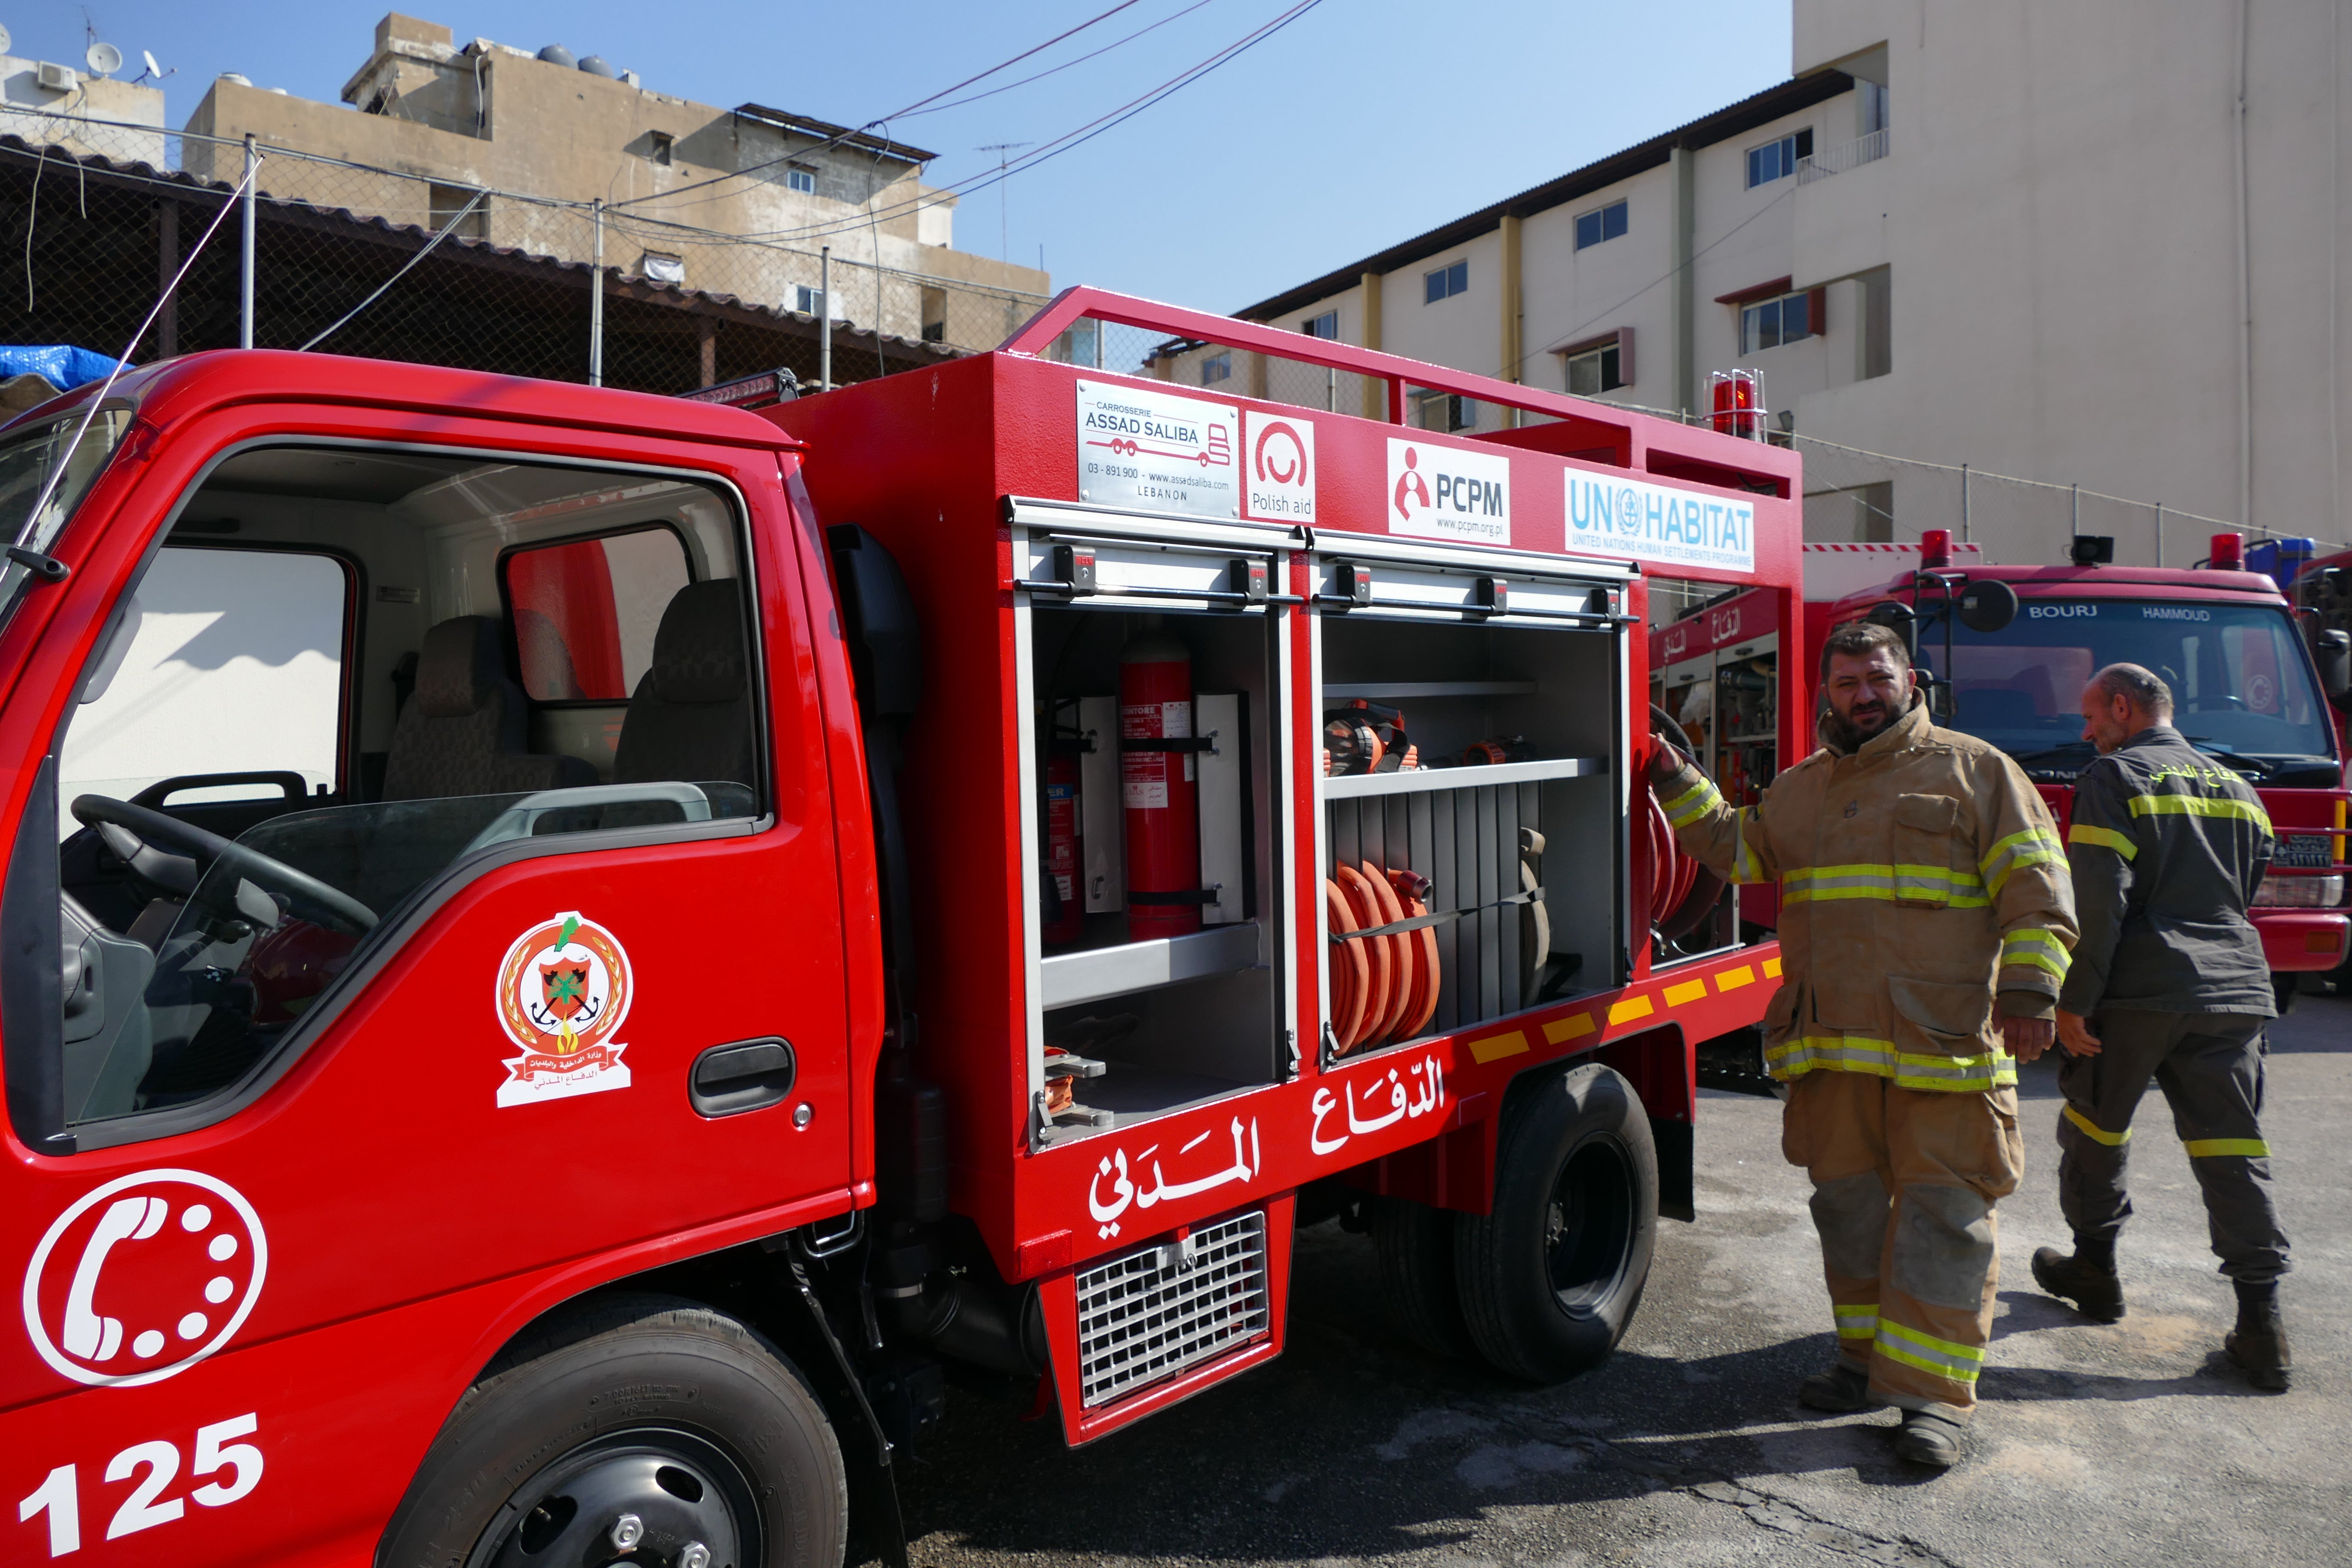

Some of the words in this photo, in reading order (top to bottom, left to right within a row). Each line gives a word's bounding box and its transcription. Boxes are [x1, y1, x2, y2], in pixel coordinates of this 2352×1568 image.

[1096, 401, 1152, 417] CARROSSERIE
[1085, 412, 1140, 434] ASSAD
[1144, 421, 1198, 444] SALIBA
[1088, 463, 1098, 473] 03
[1106, 466, 1121, 477] 891
[1123, 468, 1138, 479] 900
[1149, 472, 1229, 490] www.assadsaliba.com
[1138, 485, 1188, 501] LEBANON
[1253, 493, 1289, 512] Polish
[1293, 498, 1311, 514] aid
[1436, 473, 1503, 517] PCPM
[1571, 478, 1612, 533] UN
[1645, 492, 1751, 551] HABITAT
[1437, 517, 1503, 536] www.pcpm.org.pl
[1572, 533, 1602, 548] UNITED
[1603, 537, 1635, 552] NATIONS
[1637, 541, 1662, 555] HUMAN
[1663, 545, 1711, 561] SETTLEMENTS
[1712, 551, 1752, 567] PROGRAMME
[2029, 605, 2098, 619] BOURJ
[2142, 606, 2211, 622] HAMMOUD
[530, 1060, 556, 1069] والبلديات
[560, 1056, 584, 1069] الداخلية
[19, 1412, 264, 1558] 125
